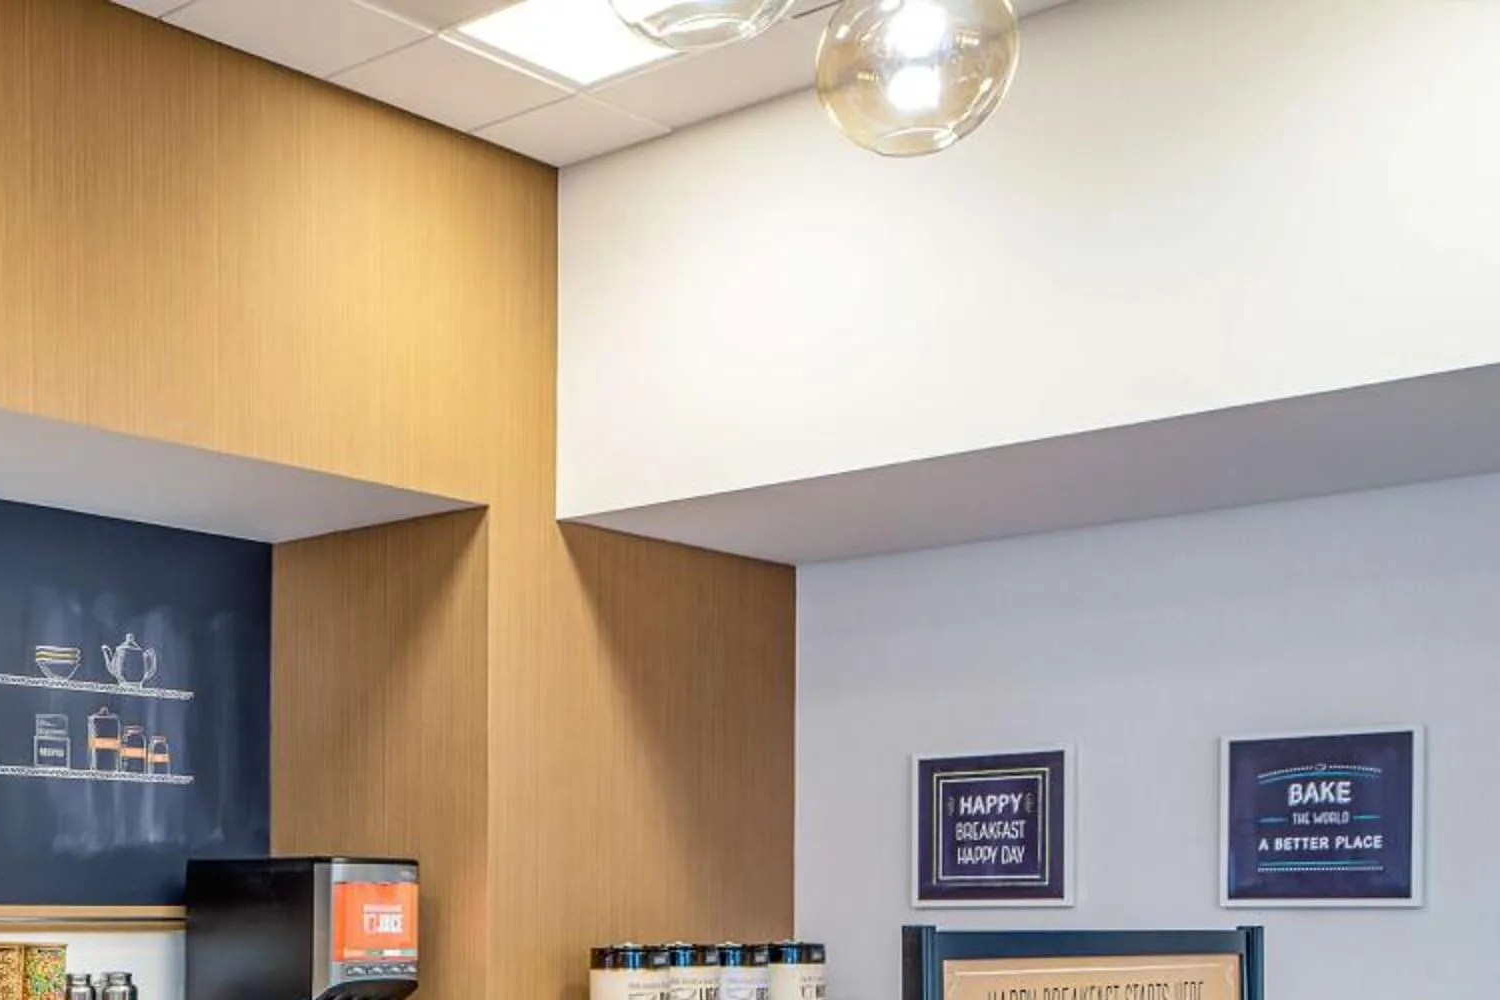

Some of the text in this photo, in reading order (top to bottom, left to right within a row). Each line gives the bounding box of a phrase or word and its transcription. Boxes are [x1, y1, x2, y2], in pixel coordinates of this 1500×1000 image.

[959, 792, 1023, 816] HAPPY
[1287, 781, 1353, 806] BAKE
[1292, 810, 1350, 825] THE WORLD
[955, 819, 1026, 841] BREAKFAST
[1257, 835, 1383, 851] A BETTER PLACE
[957, 845, 1025, 865] HAPPY DAY
